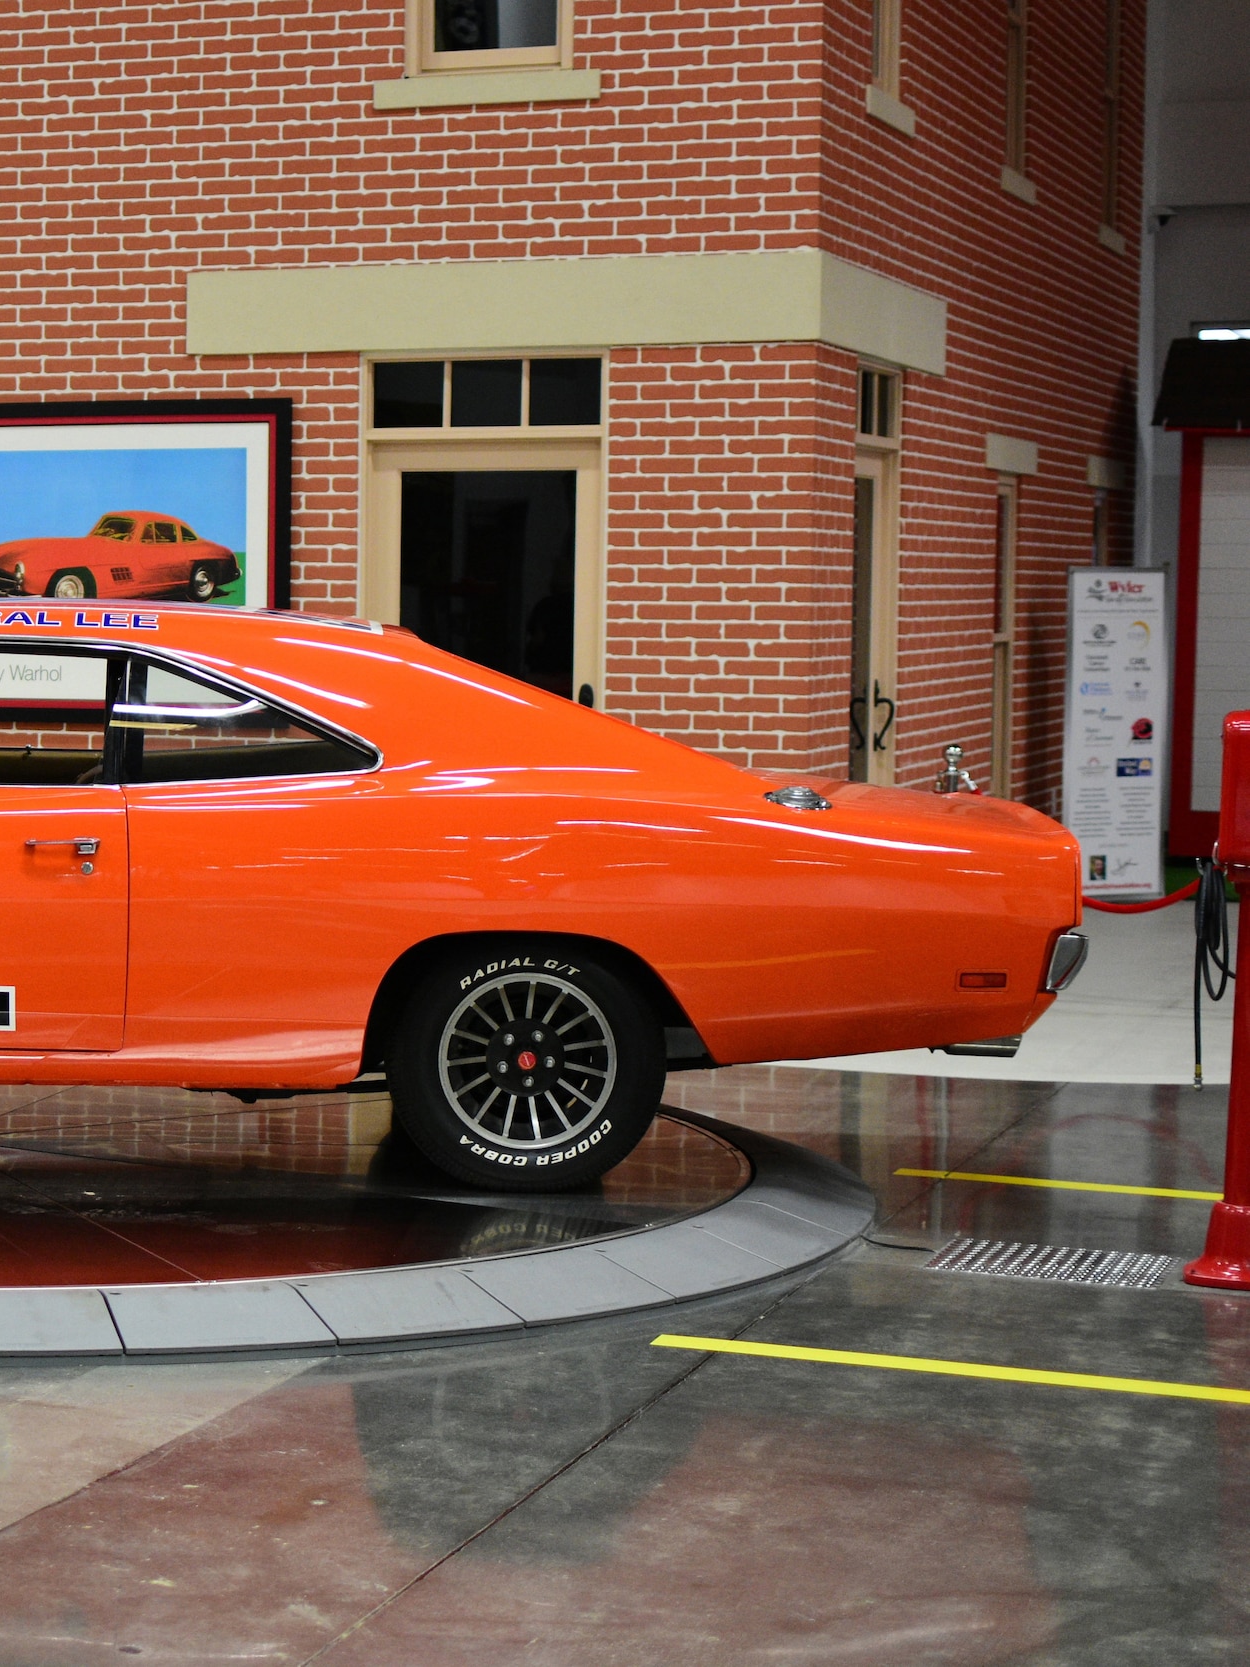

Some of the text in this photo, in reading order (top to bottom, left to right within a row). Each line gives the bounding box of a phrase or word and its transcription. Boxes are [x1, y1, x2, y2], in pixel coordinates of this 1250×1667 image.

[74, 612, 159, 630] LEE
[9, 663, 63, 683] Warhol
[459, 957, 581, 990] RADIAL G/T
[459, 1119, 612, 1166] COOPER COBRA
